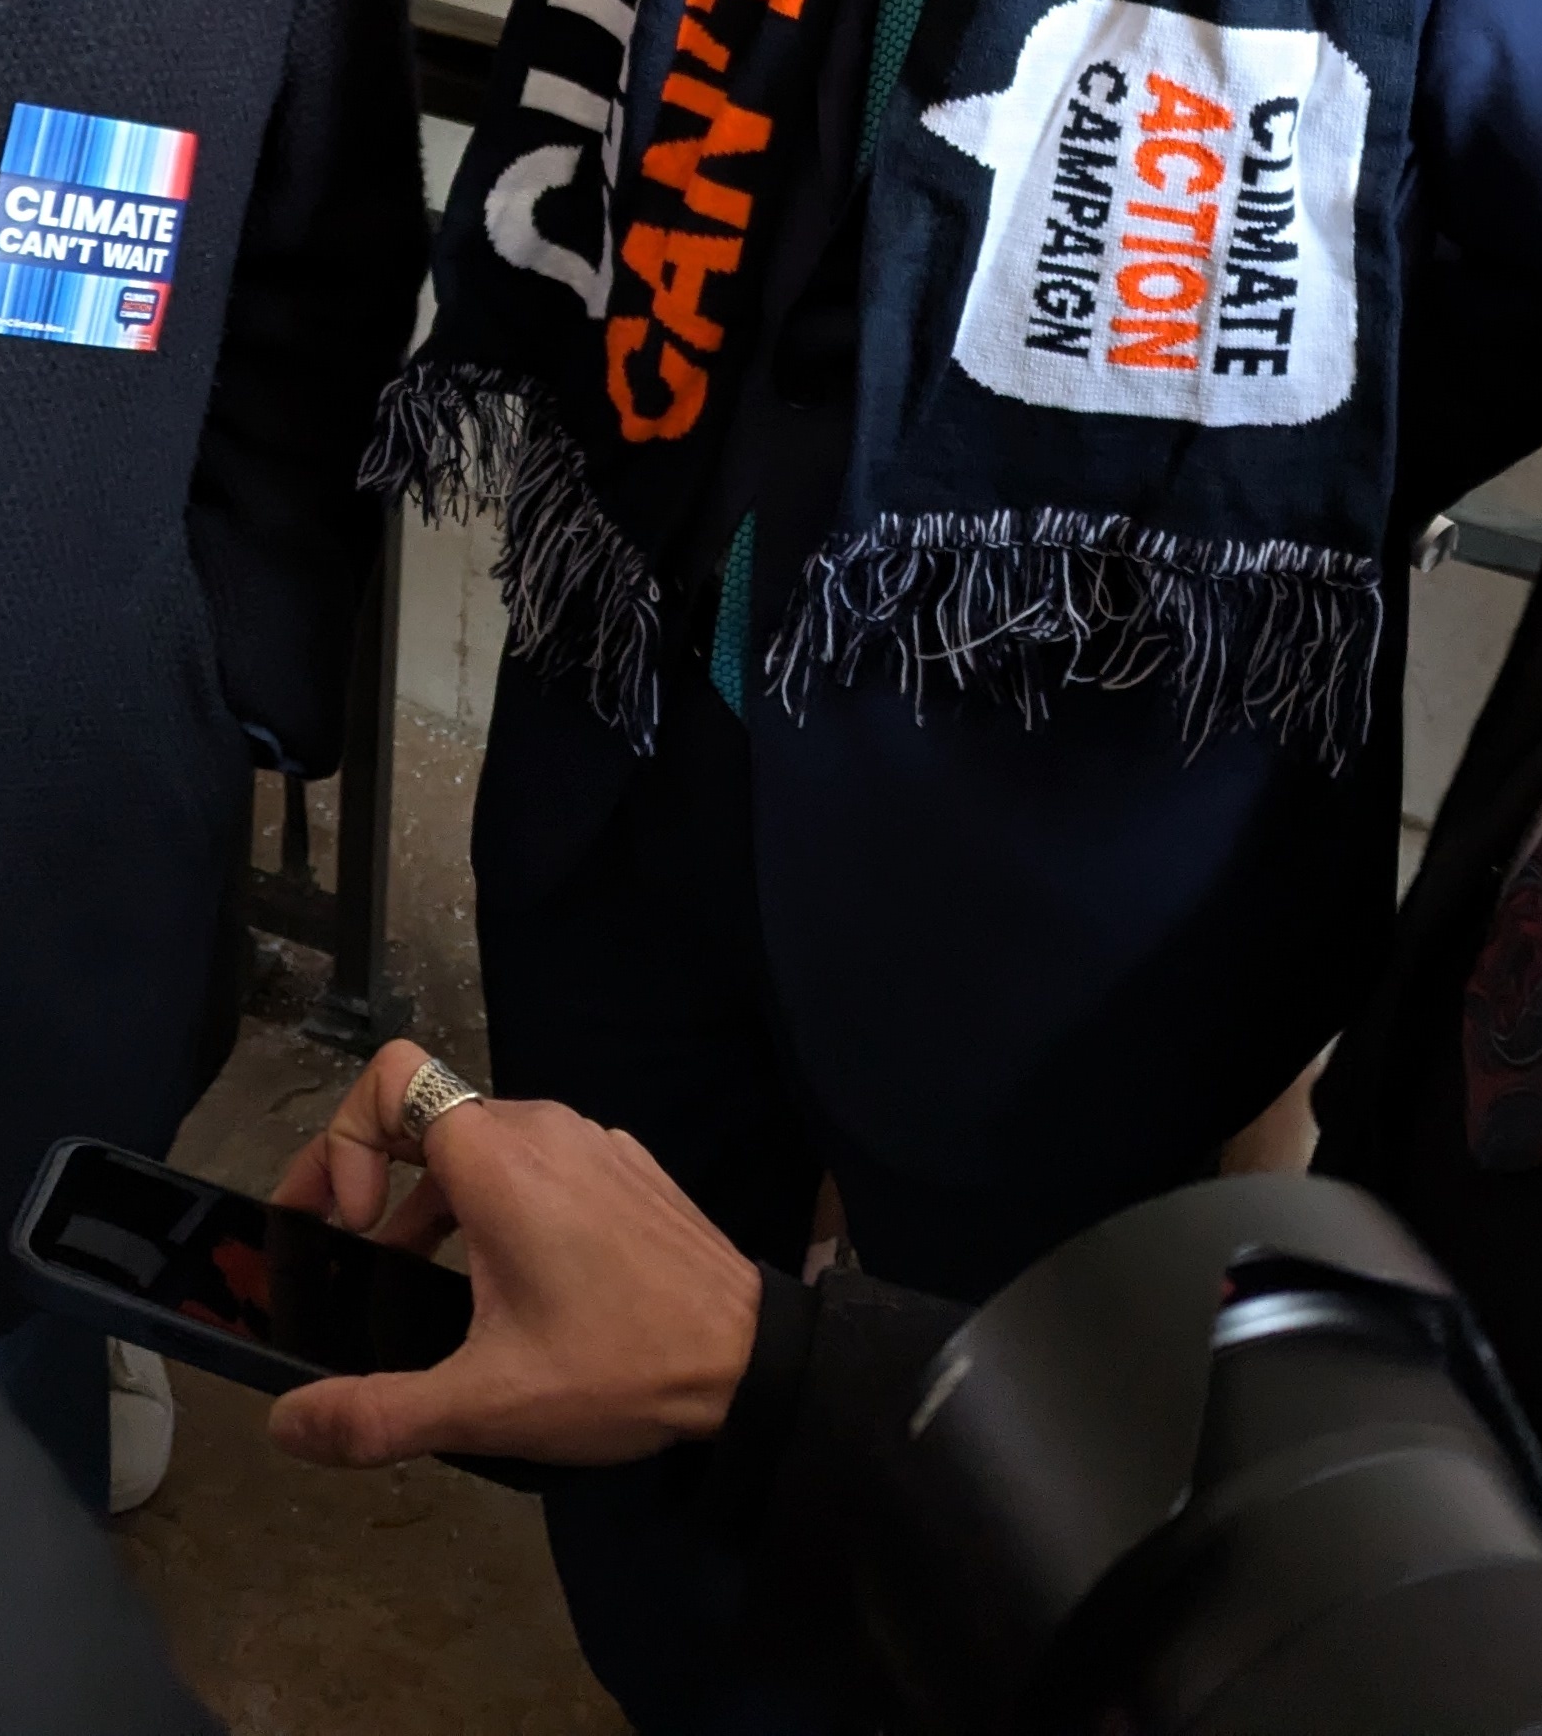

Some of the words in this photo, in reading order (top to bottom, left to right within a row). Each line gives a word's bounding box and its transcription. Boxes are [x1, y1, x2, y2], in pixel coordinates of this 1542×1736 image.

[4, 185, 178, 244] CLIMATE
[102, 241, 170, 275] WAIT
[1025, 60, 1128, 360] CAMPAIGN
[1106, 70, 1235, 371] ACTION
[1212, 95, 1300, 377] CLIMATE
